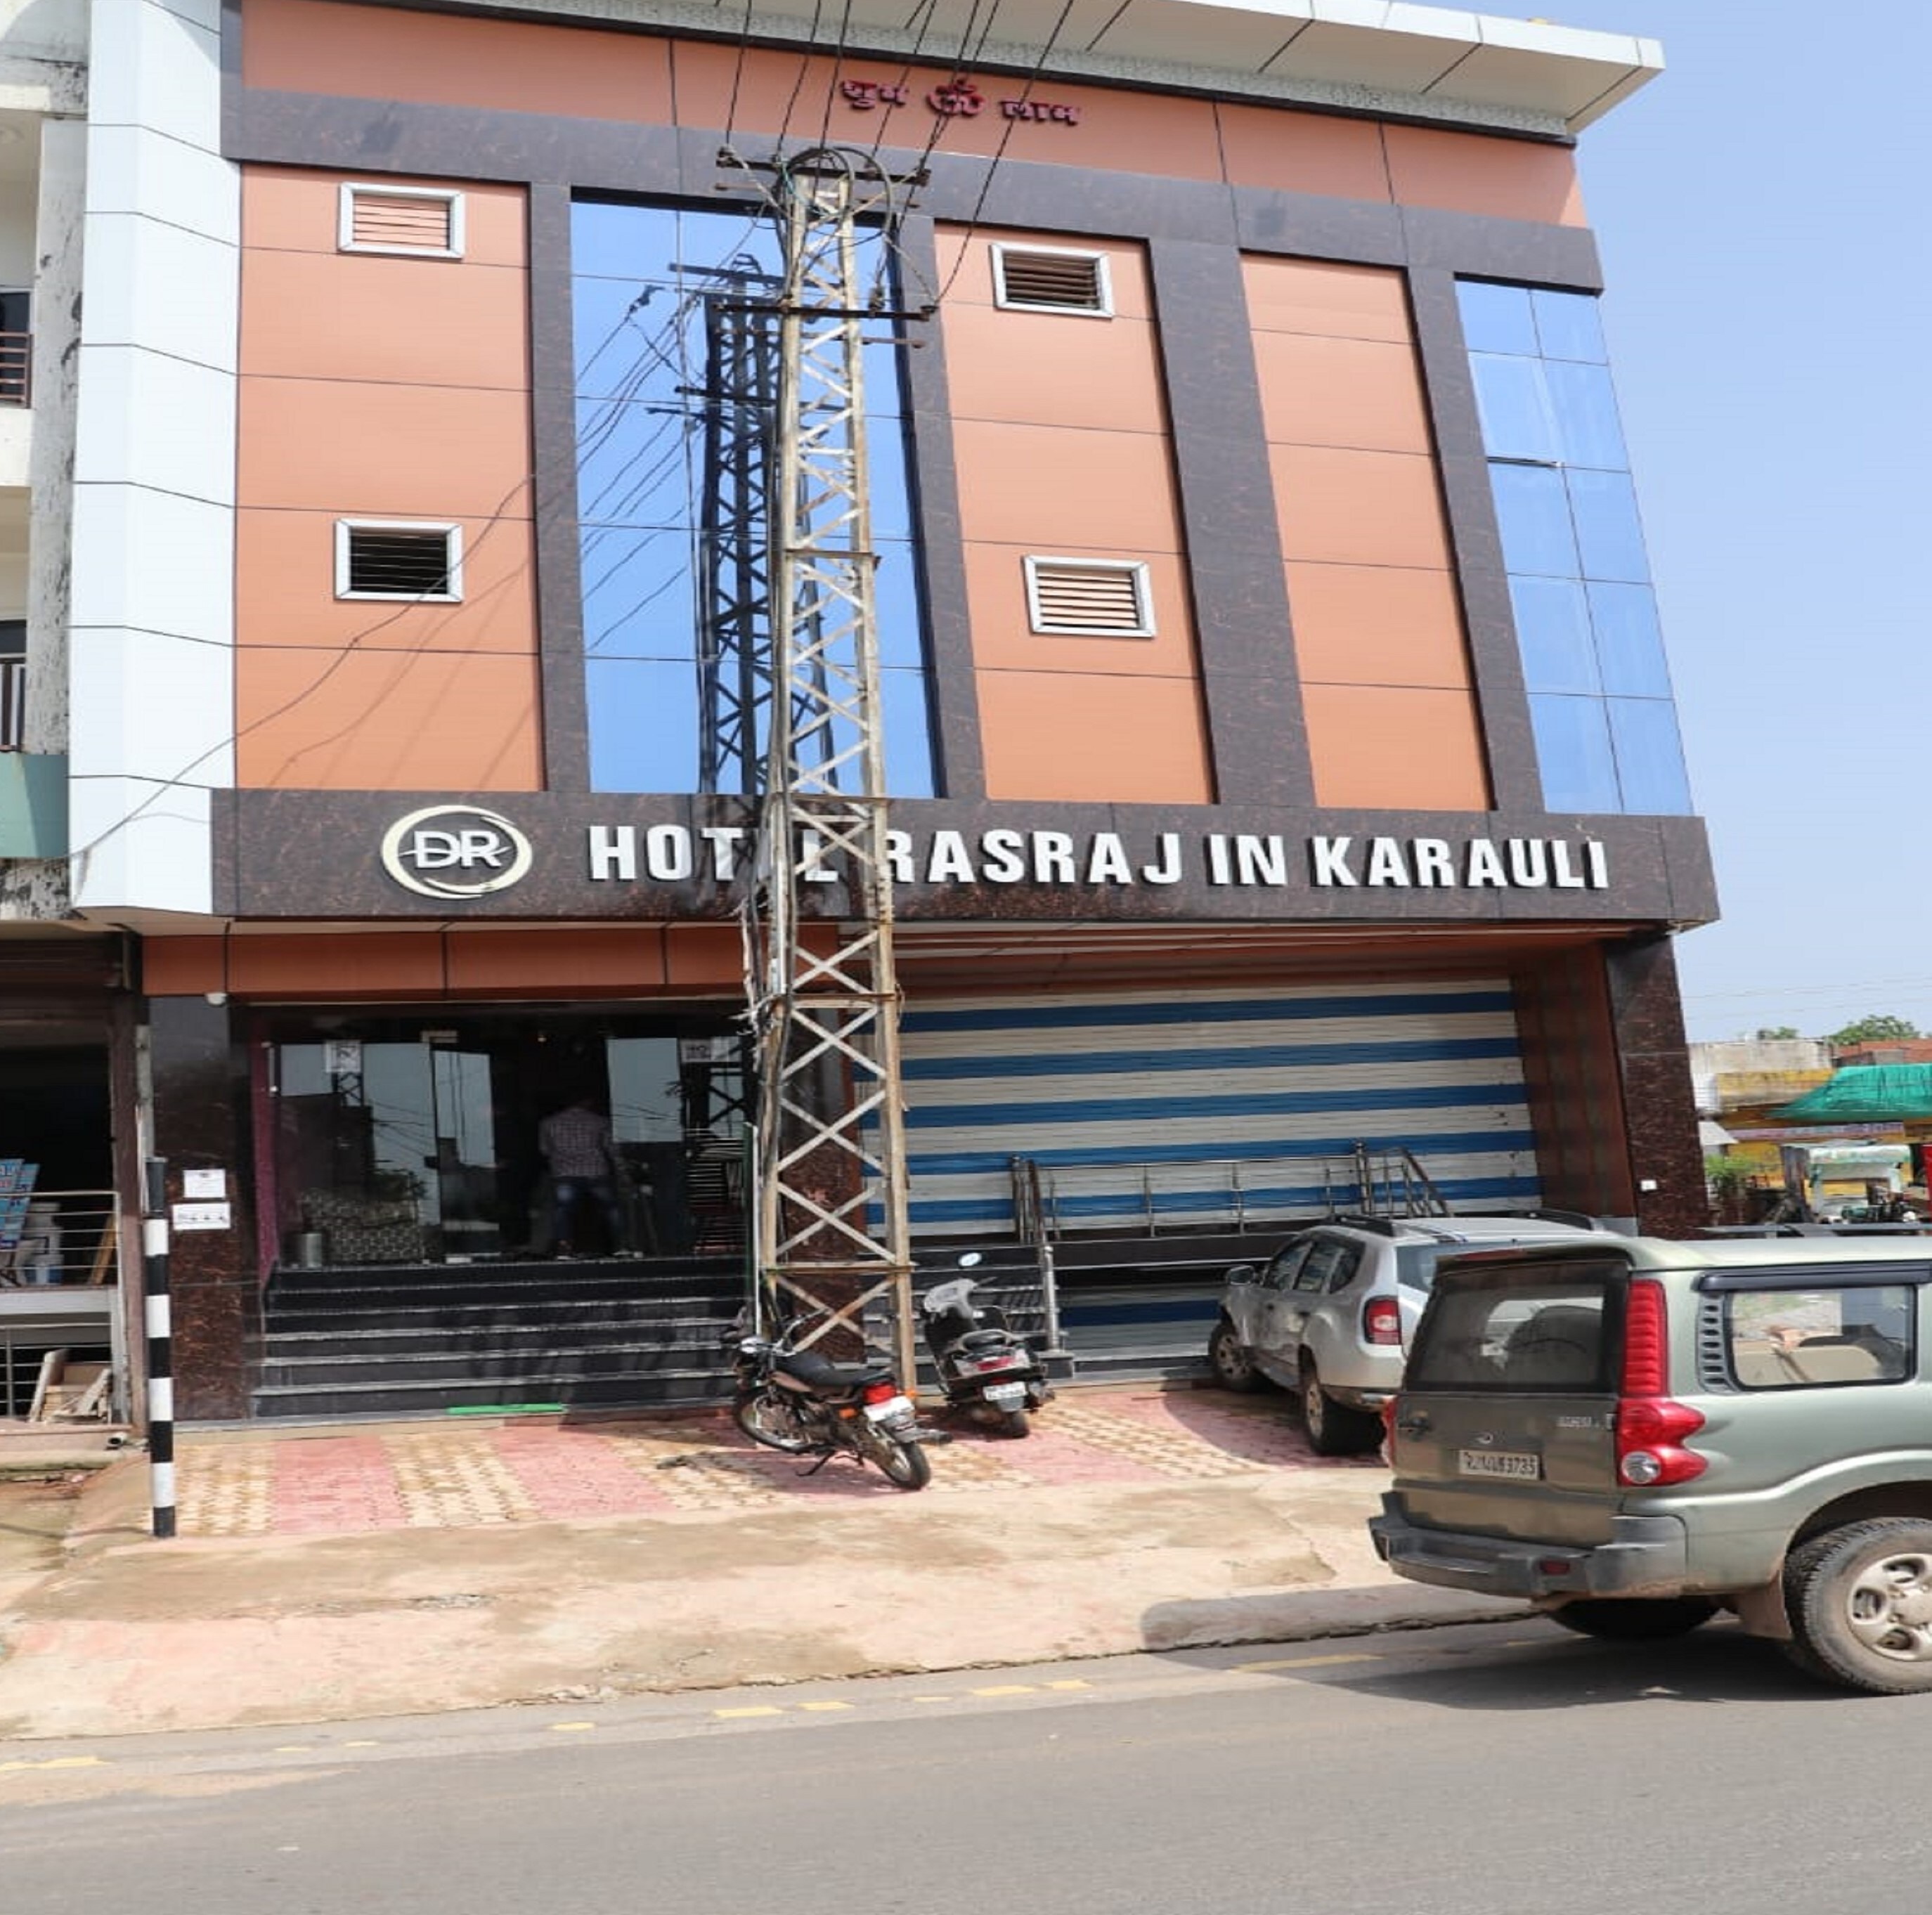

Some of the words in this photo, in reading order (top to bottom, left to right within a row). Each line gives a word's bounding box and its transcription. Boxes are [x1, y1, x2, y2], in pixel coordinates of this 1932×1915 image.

[413, 831, 503, 869] DR
[588, 824, 839, 883] HOTL
[886, 829, 1182, 884] RASRAJ
[1207, 833, 1288, 886] IN
[1311, 836, 1610, 890] KARAULI
